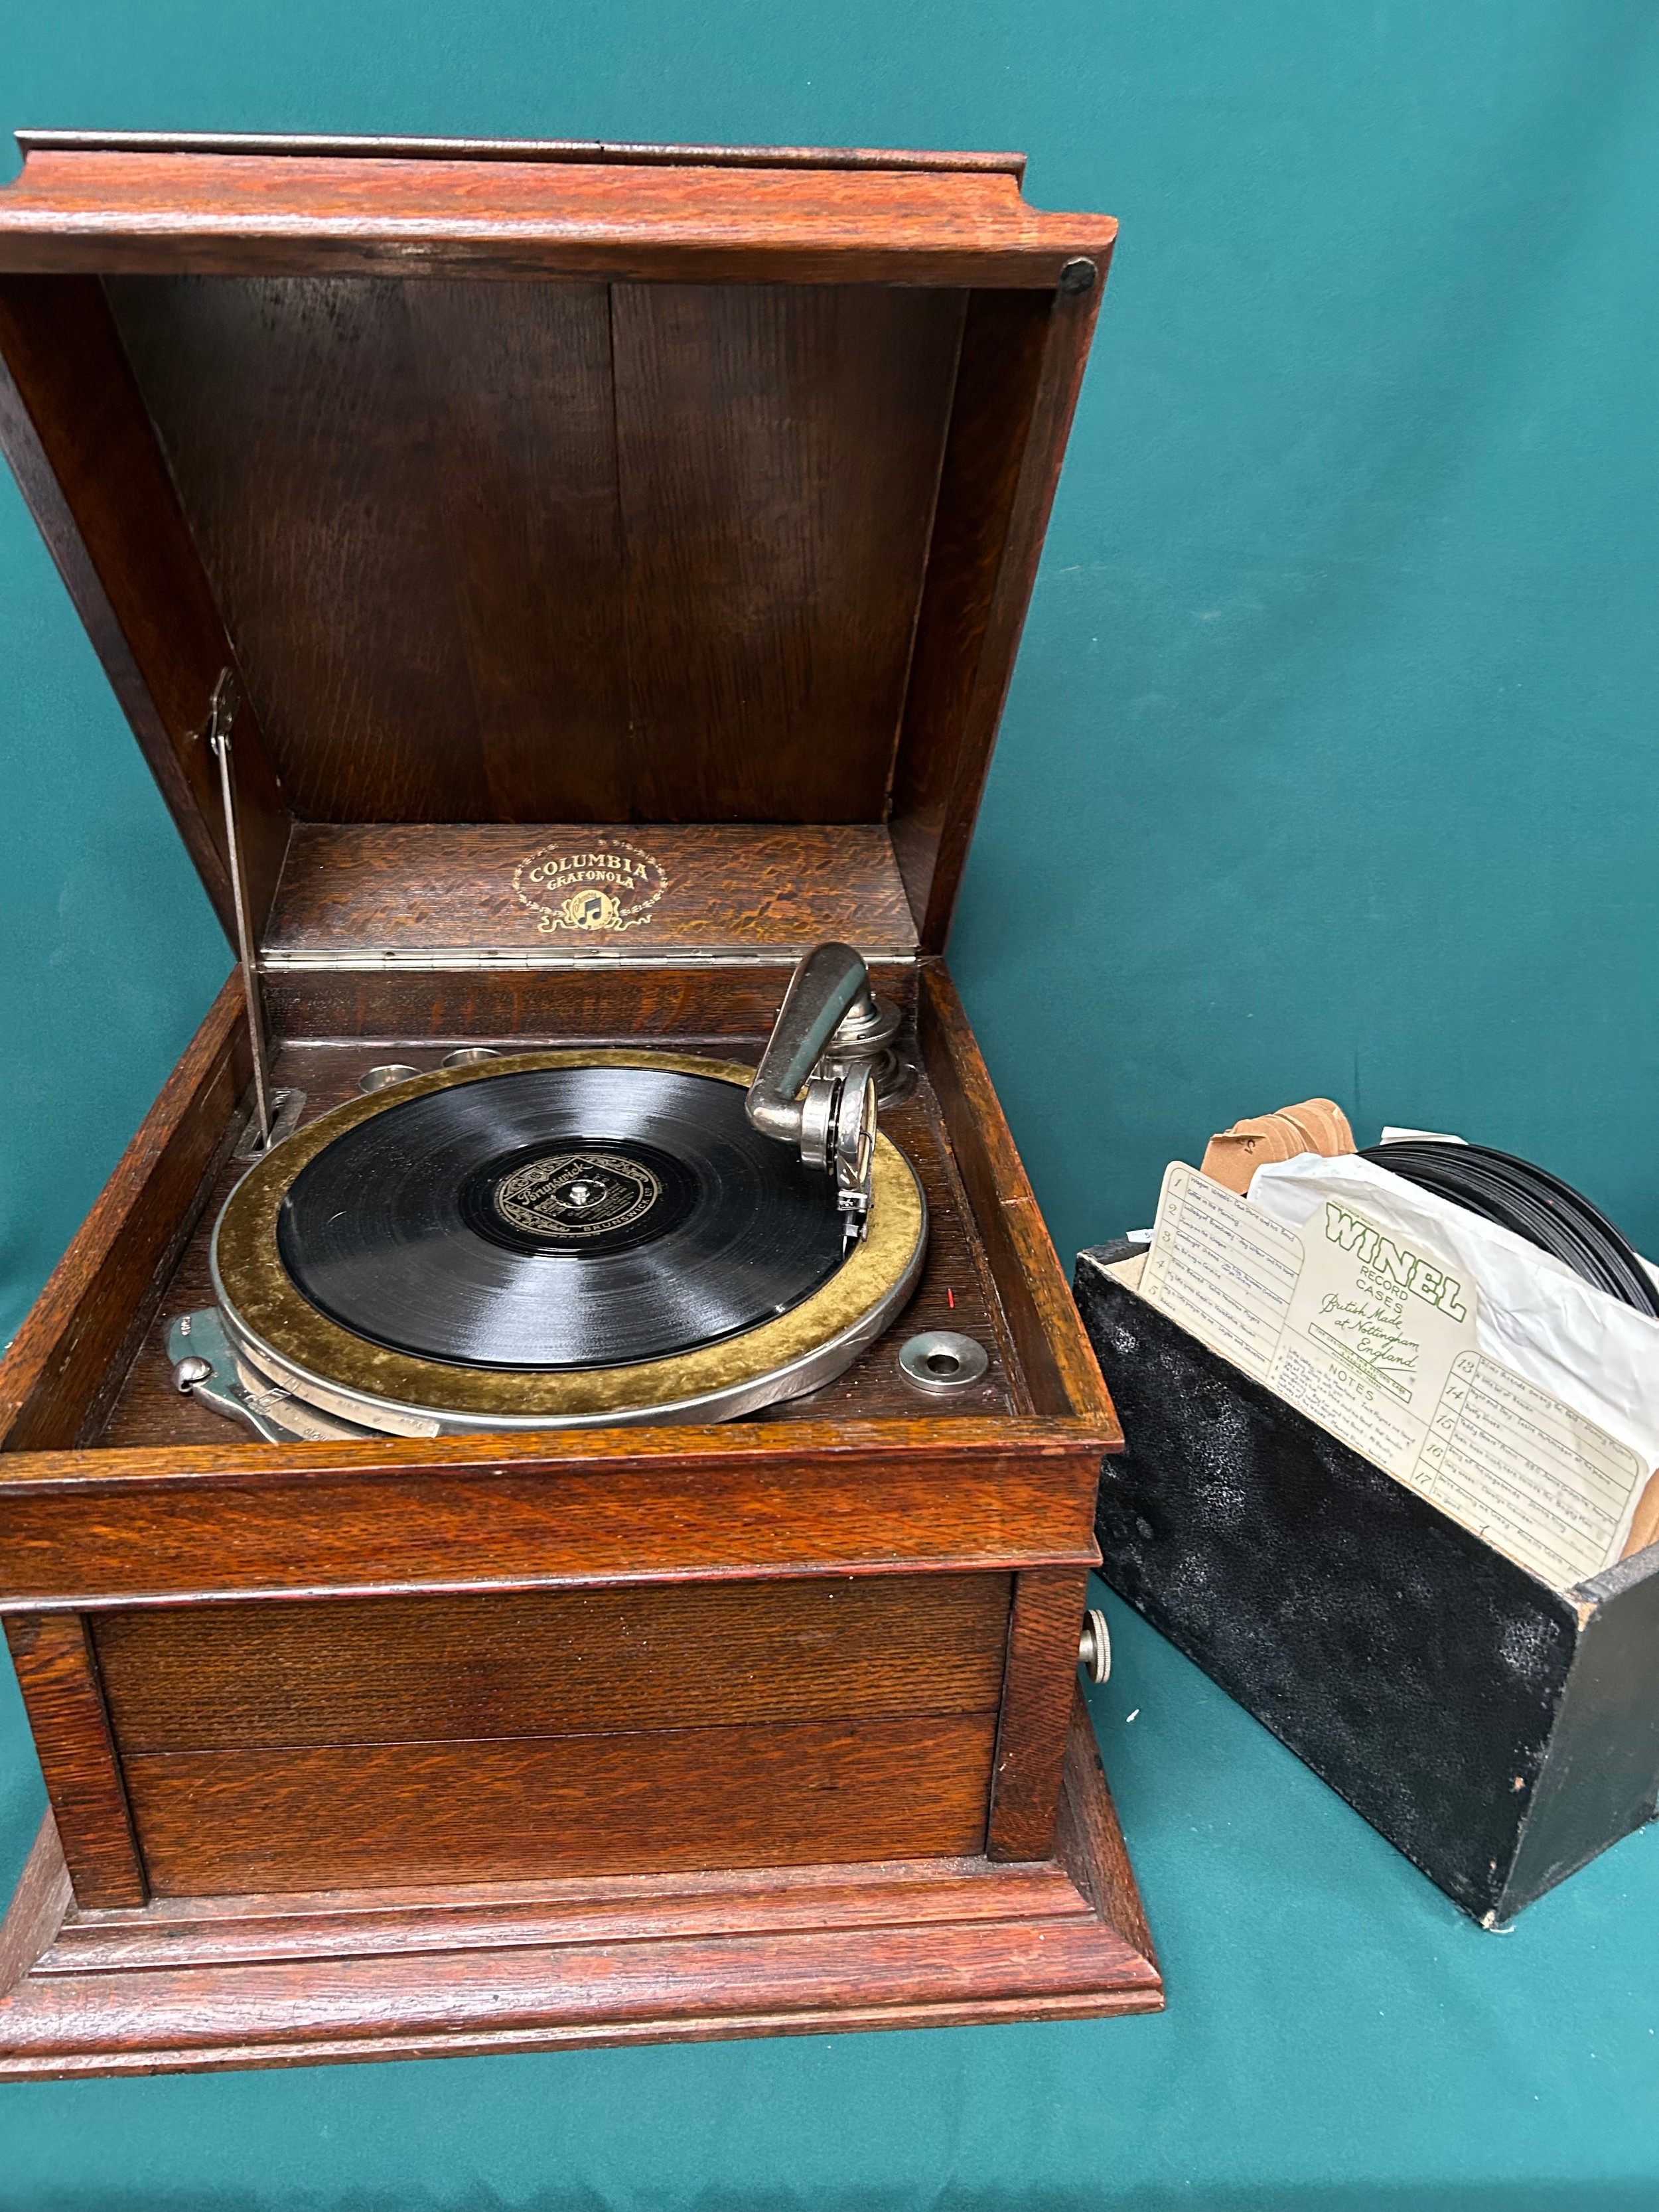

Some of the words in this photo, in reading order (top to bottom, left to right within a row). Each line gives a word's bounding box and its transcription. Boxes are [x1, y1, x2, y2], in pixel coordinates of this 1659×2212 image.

[530, 854, 648, 883] COLUMBIA
[547, 870, 634, 890] GRAFONOLA
[518, 1163, 593, 1205] Brunswick
[1174, 1175, 1182, 1189] 1
[583, 1199, 650, 1231] BRUNSWICK
[1167, 1201, 1177, 1217] 2
[1161, 1228, 1172, 1244] 3
[1155, 1255, 1165, 1271] 4
[1326, 1202, 1467, 1323] WINEL
[1148, 1282, 1158, 1297] 5
[1360, 1266, 1408, 1301] RECORD
[1356, 1279, 1404, 1313] CASES
[1319, 1293, 1366, 1314] British
[1367, 1307, 1403, 1329] Made
[1334, 1319, 1350, 1330] at
[1348, 1320, 1419, 1352] Nottingham
[1357, 1337, 1419, 1368] England
[1457, 1355, 1475, 1375] 13
[1329, 1364, 1374, 1400] NOTES
[1445, 1382, 1464, 1403] 14
[1435, 1410, 1455, 1433] 15
[1426, 1440, 1443, 1460] 16
[1414, 1468, 1432, 1489] 17
